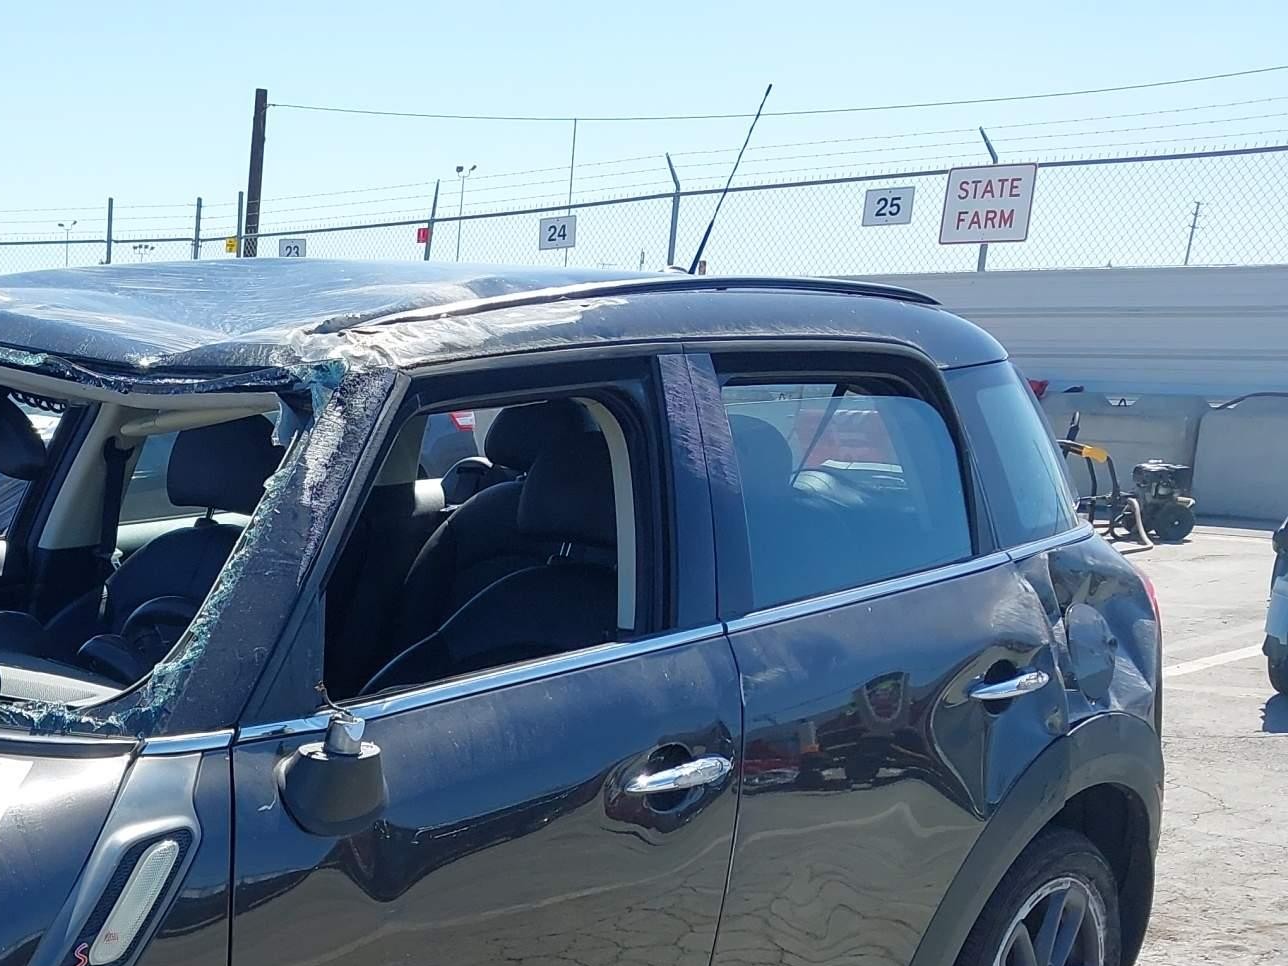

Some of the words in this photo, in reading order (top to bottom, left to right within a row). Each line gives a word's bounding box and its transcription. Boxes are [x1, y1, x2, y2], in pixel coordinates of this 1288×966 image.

[957, 177, 1022, 200] STATE
[874, 196, 902, 217] 25
[956, 208, 1015, 231] FARM
[546, 224, 567, 242] 24
[285, 245, 300, 257] 23
